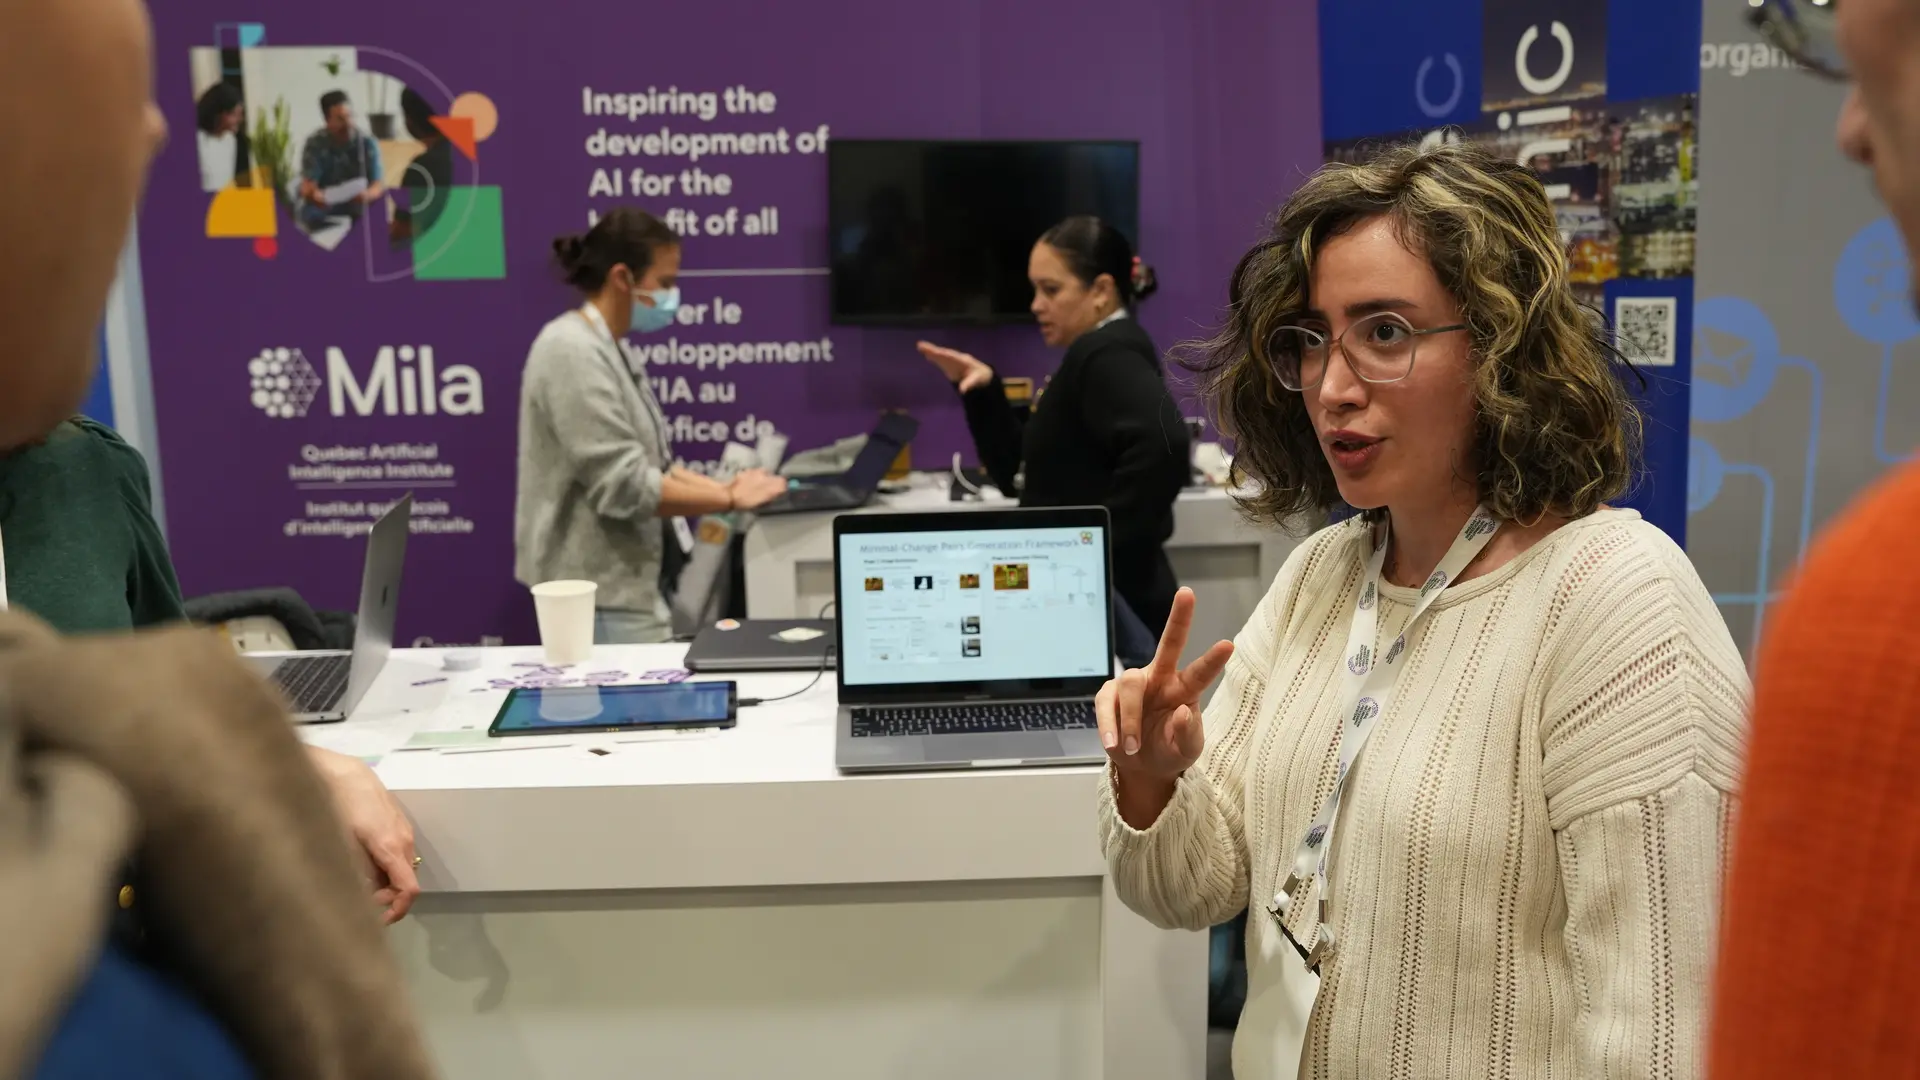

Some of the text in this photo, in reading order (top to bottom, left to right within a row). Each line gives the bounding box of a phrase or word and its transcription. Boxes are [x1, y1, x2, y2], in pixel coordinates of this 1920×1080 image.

[583, 85, 776, 121] Inspiring the
[585, 124, 829, 162] development of
[588, 167, 732, 197] AI for the
[704, 207, 738, 235] of
[742, 206, 778, 235] all
[714, 297, 742, 324] le
[325, 345, 484, 416] Mila
[699, 382, 736, 402] au
[734, 413, 775, 442] de
[369, 443, 438, 460] Artificial
[288, 463, 455, 482] Intelligence Institute
[306, 502, 365, 517] Institut
